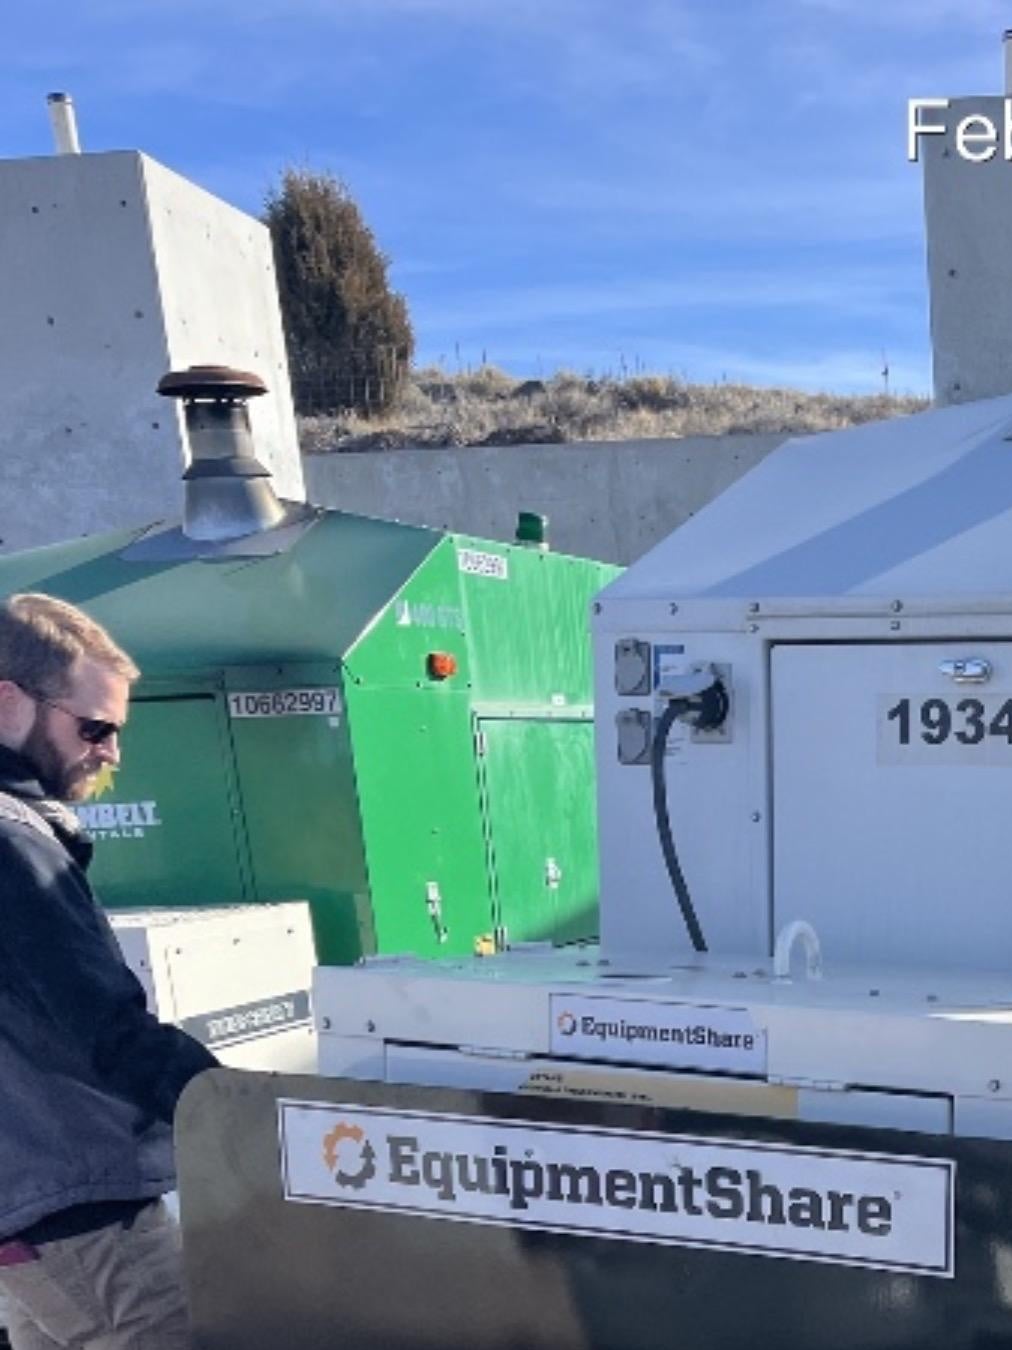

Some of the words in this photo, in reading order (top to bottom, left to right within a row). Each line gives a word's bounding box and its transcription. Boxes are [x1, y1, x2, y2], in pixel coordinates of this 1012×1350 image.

[231, 690, 338, 715] 10662997
[580, 1014, 756, 1052] EquipmentShare
[386, 1134, 895, 1238] EquipmentShare
